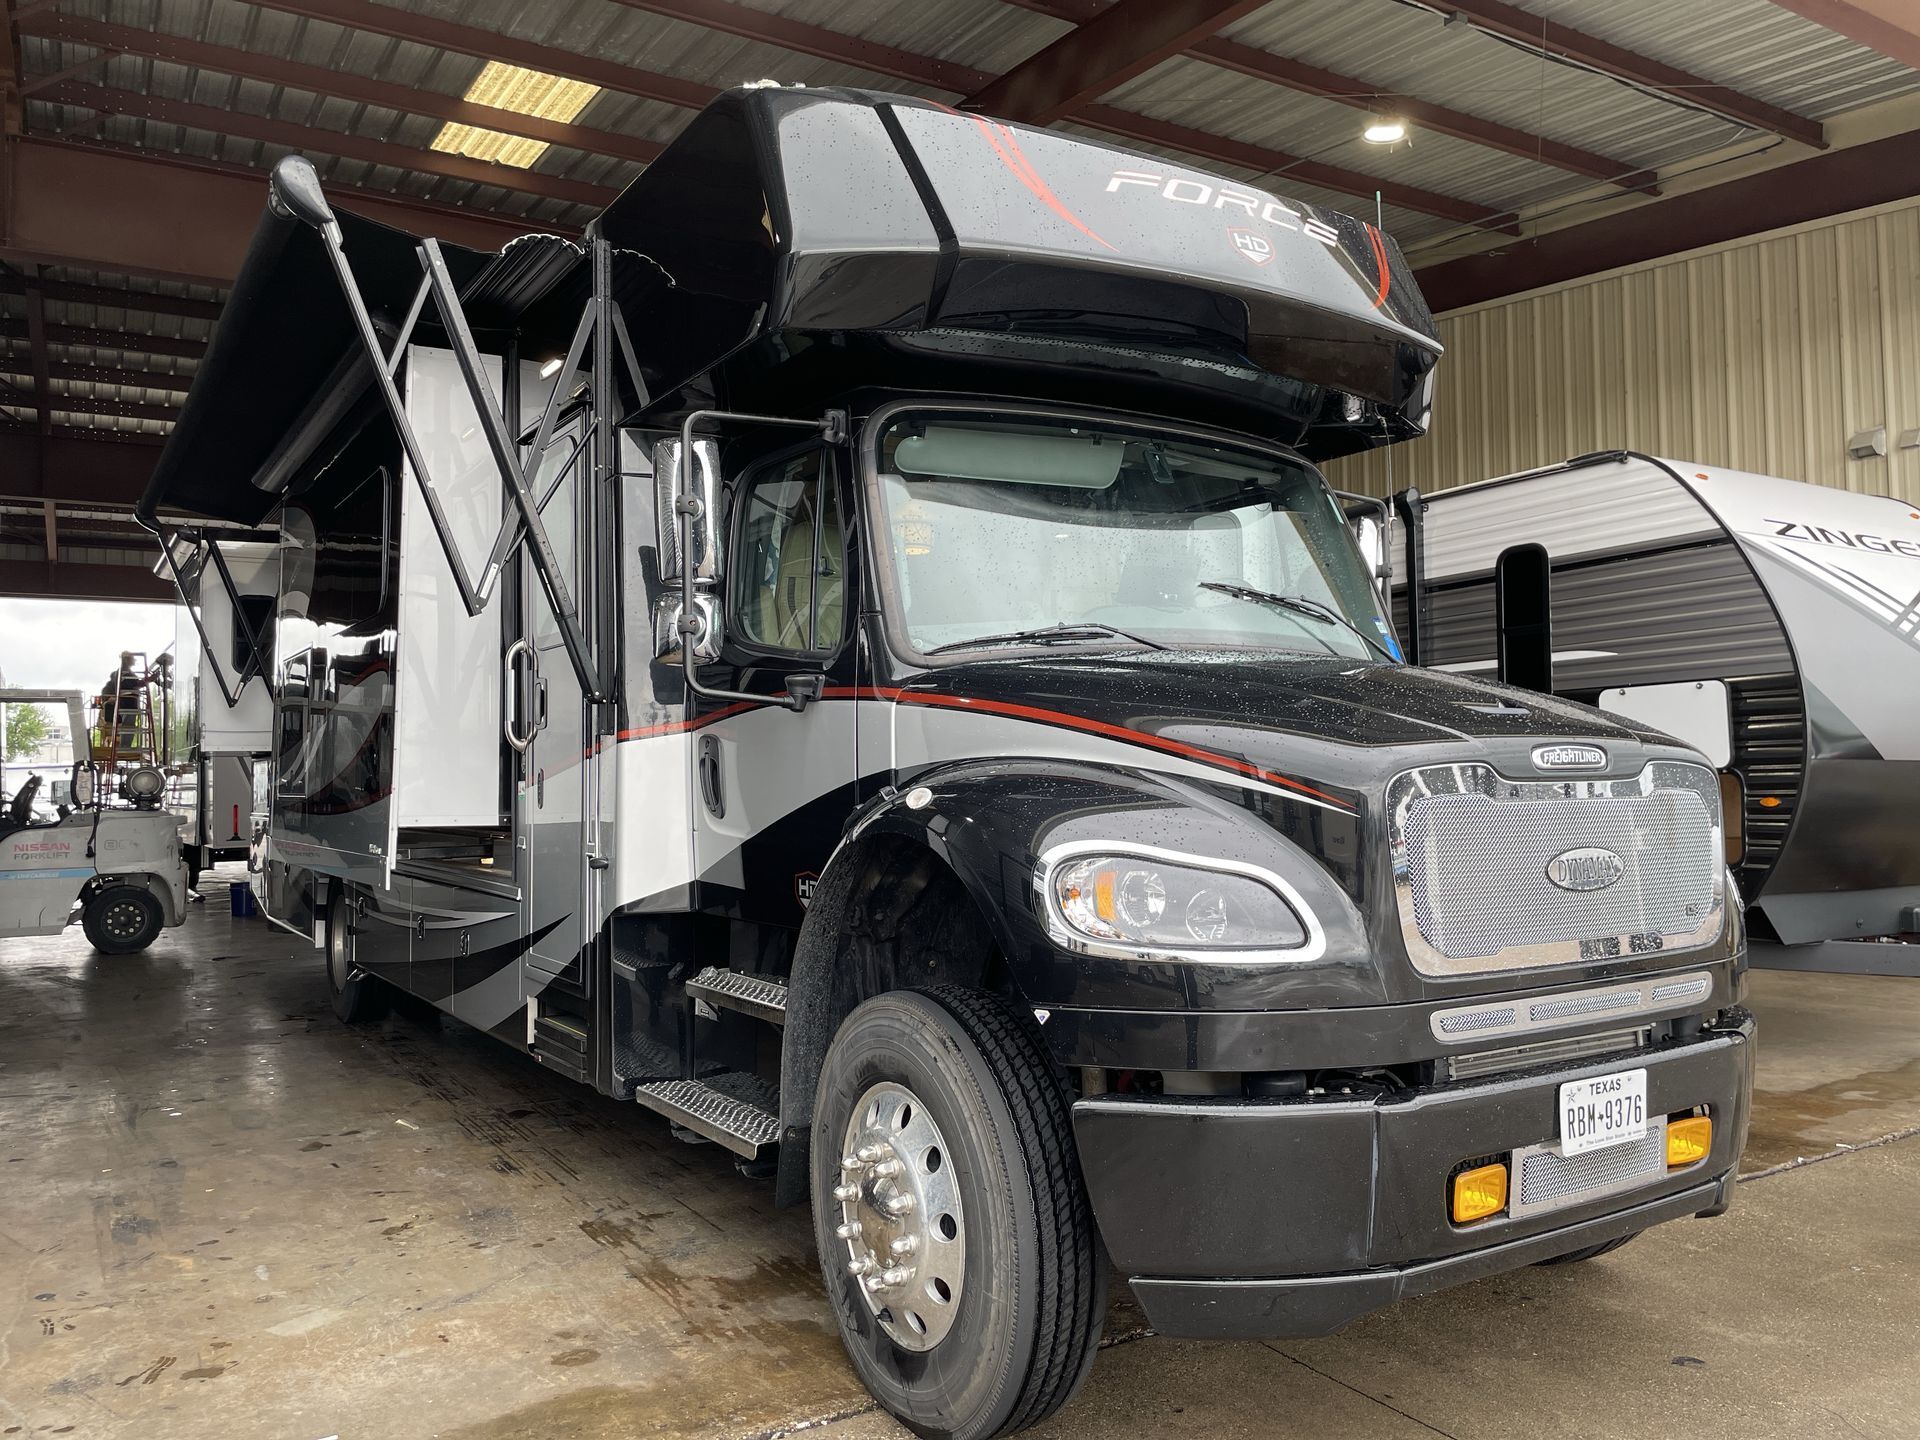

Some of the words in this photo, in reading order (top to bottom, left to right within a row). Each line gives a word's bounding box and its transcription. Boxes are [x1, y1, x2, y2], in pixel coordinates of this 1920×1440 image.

[1105, 170, 1339, 248] FORCE
[1233, 232, 1270, 253] HD
[1763, 518, 1920, 558] ZINGE
[1543, 748, 1601, 764] FREIGHTLINER
[14, 842, 71, 852] NISSAN
[14, 851, 71, 861] FORKLIFT
[1557, 855, 1618, 882] DYNAMAX
[1589, 1078, 1622, 1097] TEXAS
